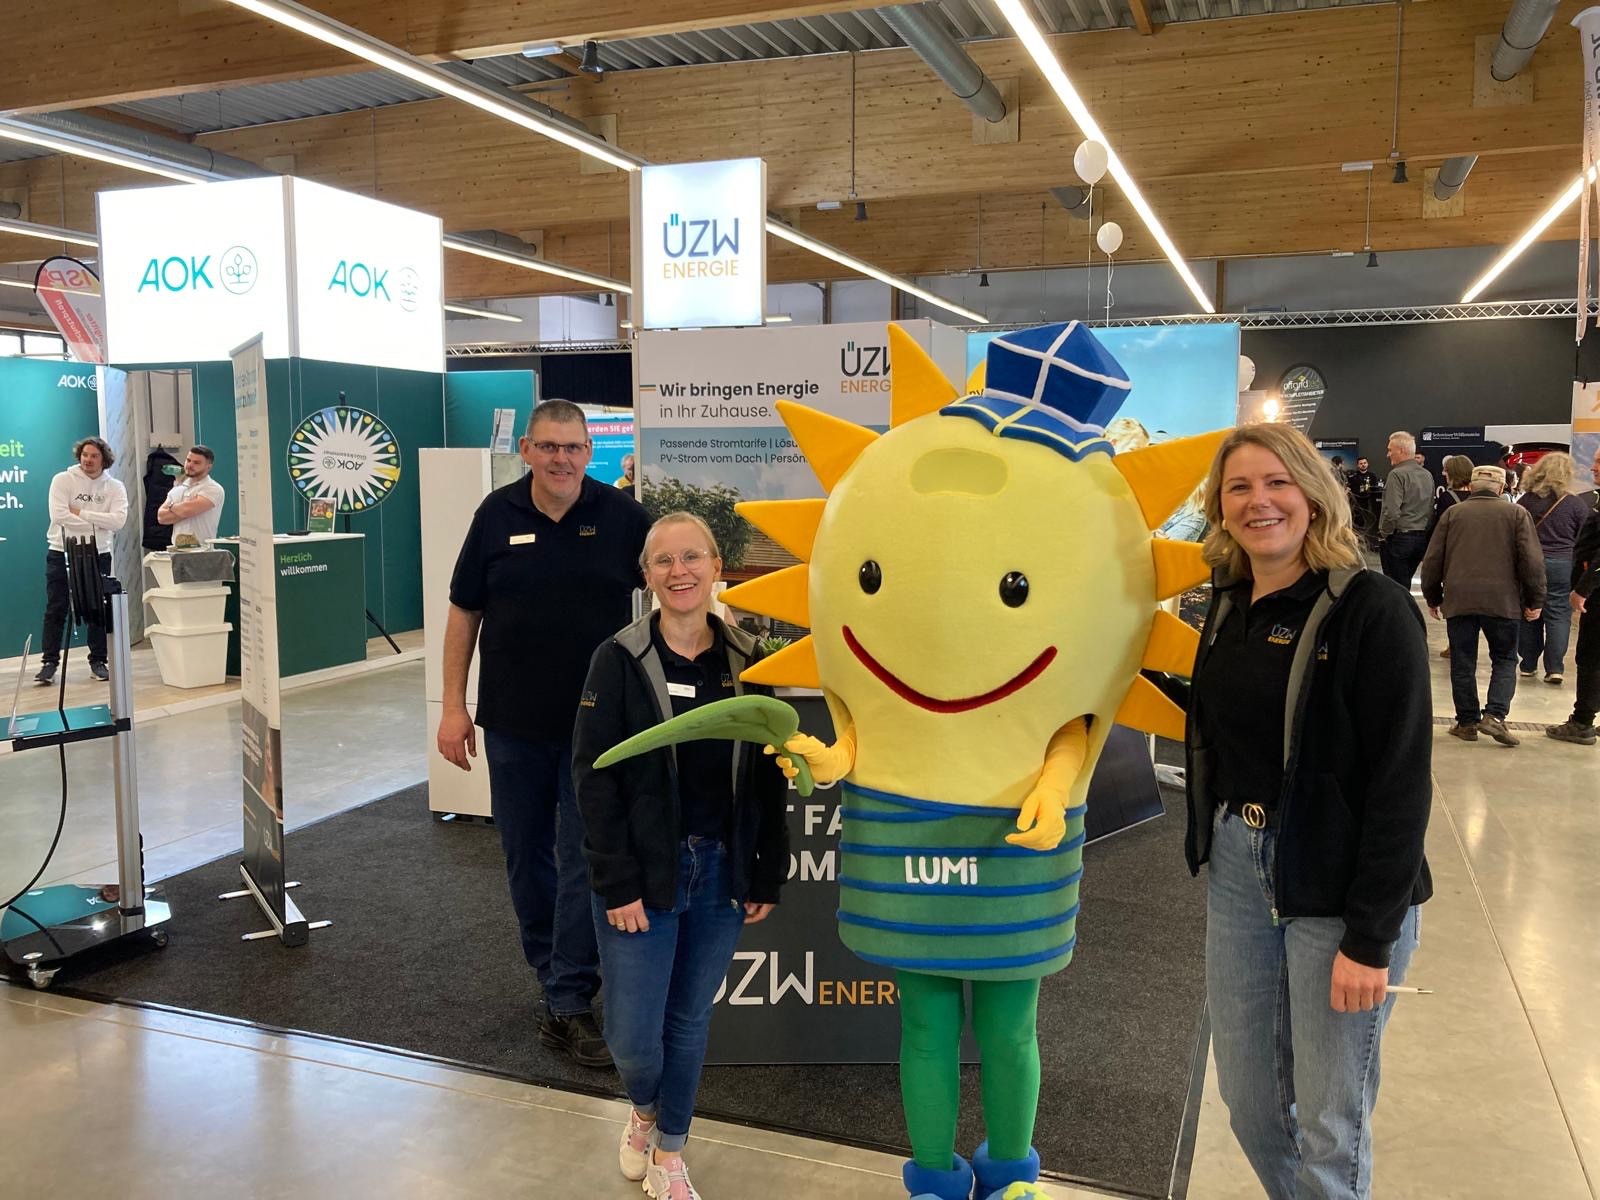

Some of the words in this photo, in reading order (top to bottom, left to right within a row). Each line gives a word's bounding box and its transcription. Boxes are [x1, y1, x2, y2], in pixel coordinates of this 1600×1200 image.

[663, 213, 739, 258] ÜZW
[138, 254, 214, 293] AOK
[663, 259, 739, 279] ENERGIE
[328, 260, 392, 302] AOK
[57, 374, 87, 389] AOK
[840, 379, 891, 393] ENERG
[660, 382, 686, 397] Wir
[690, 381, 753, 400] bringen
[757, 380, 820, 399] Energie
[660, 404, 673, 418] in
[677, 404, 696, 418] Ihr
[701, 404, 772, 418] Zuhause.
[587, 425, 609, 433] erden
[622, 424, 633, 434] gef
[0, 439, 25, 457] eit
[660, 438, 708, 449] Passende
[710, 438, 767, 449] Stromtarife
[775, 438, 798, 449] Lösu
[337, 459, 364, 471] AOK
[660, 454, 708, 463] PV-Strom
[710, 455, 733, 463] vom
[735, 453, 762, 463] Dach
[770, 453, 808, 463] Persön
[280, 552, 313, 564] Herzlich
[280, 563, 328, 577] willkommen
[904, 855, 978, 885] LUMi
[713, 951, 814, 1006] ZW
[819, 980, 901, 1005] ENER
